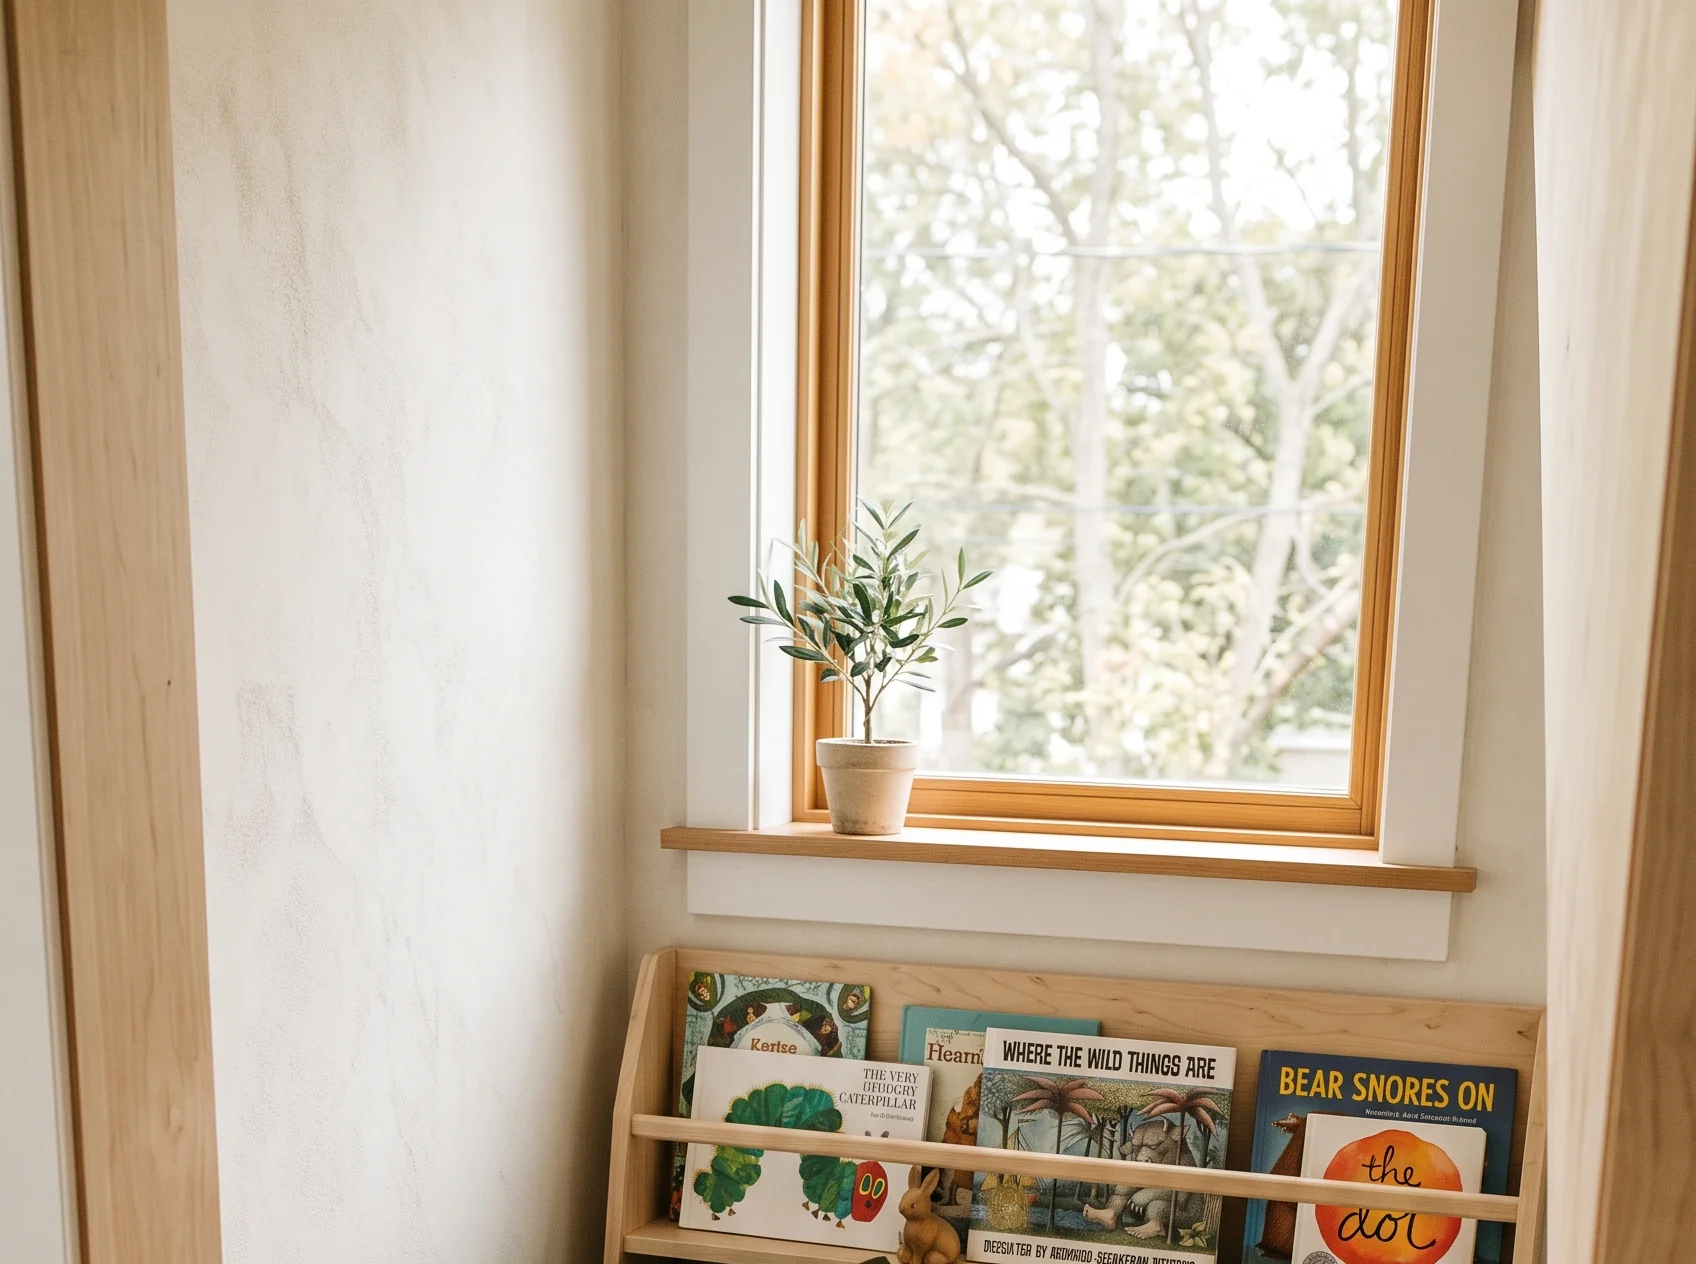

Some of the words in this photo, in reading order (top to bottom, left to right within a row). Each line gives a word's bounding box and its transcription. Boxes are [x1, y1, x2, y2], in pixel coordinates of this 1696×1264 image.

[863, 1068, 887, 1081] THE
[889, 1070, 919, 1084] VERY
[1003, 1040, 1053, 1066] WHERE
[1056, 1045, 1083, 1068] THE
[1087, 1048, 1123, 1072] WILD
[1127, 1050, 1182, 1077] THINGS
[1184, 1056, 1217, 1080] ARE
[839, 1091, 917, 1110] CATERPILLAR
[1279, 1066, 1344, 1100] BEAR
[1351, 1072, 1450, 1109] SNORES
[1457, 1080, 1496, 1113] ON
[1361, 1144, 1422, 1188] the
